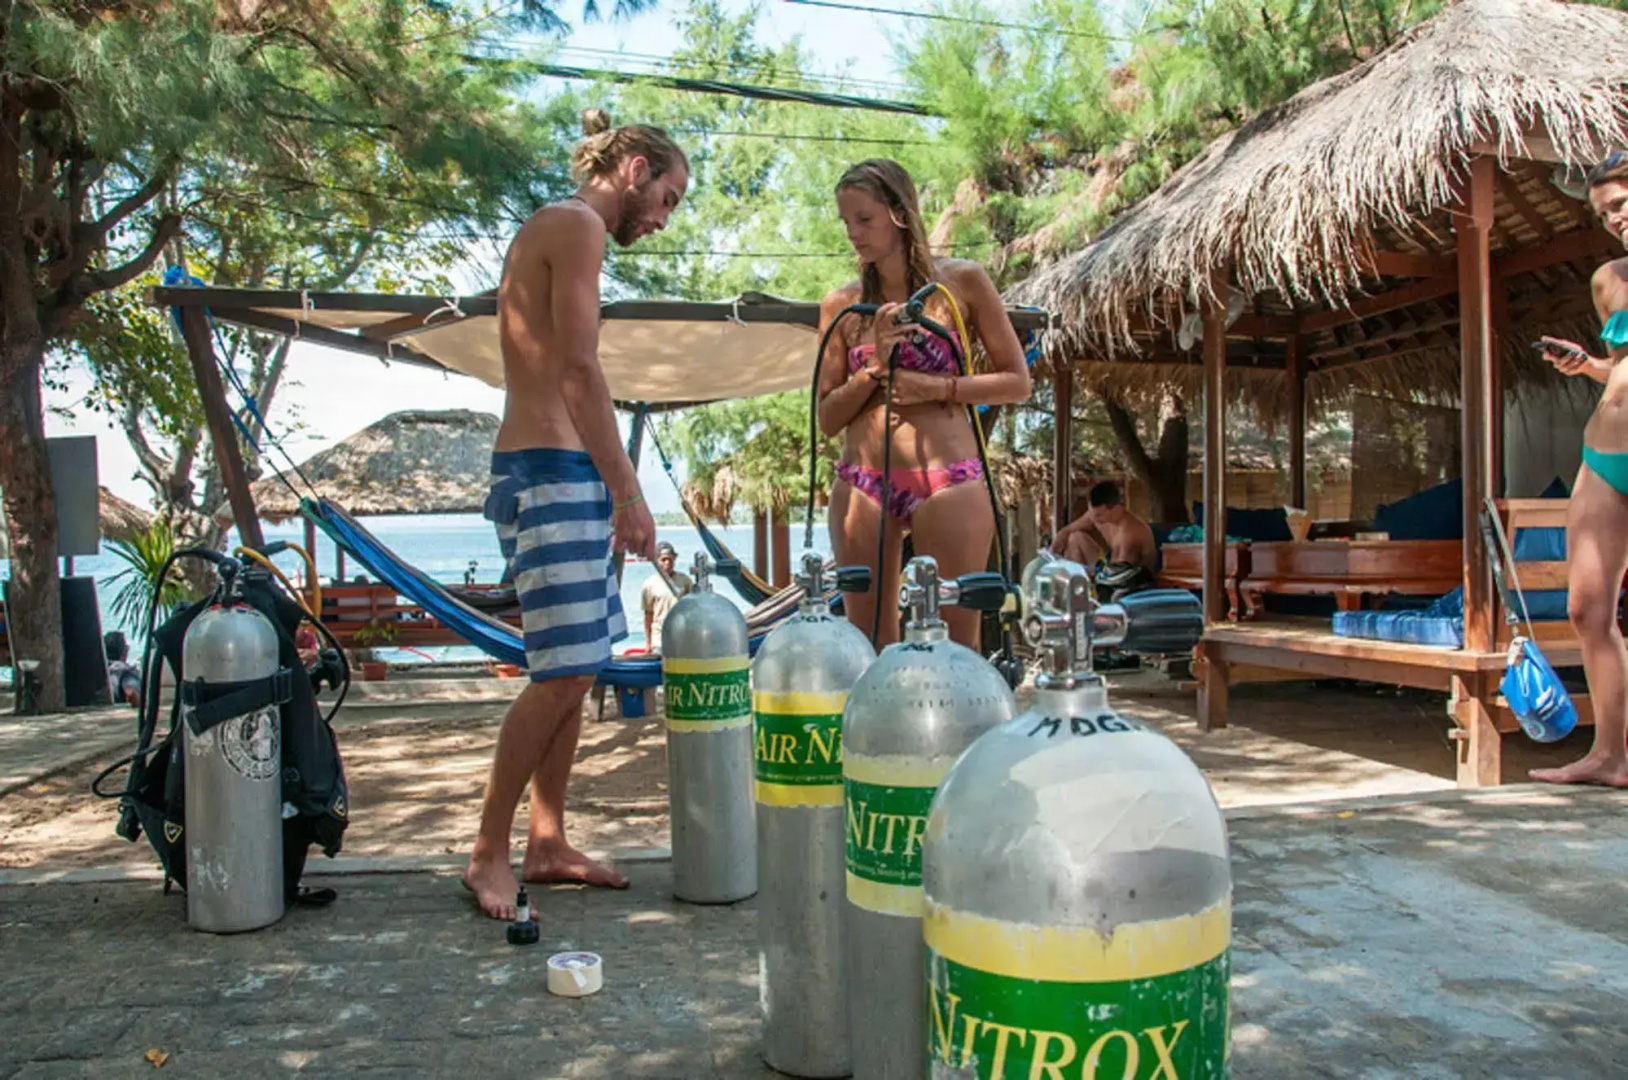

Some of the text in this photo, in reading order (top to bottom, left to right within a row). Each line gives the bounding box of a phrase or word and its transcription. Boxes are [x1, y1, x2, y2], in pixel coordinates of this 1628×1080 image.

[667, 681, 749, 708] IR NITRO
[755, 725, 798, 764] AIR
[1027, 714, 1141, 738] MDG
[846, 796, 930, 856] NITR
[928, 979, 1191, 1080] NITROX
